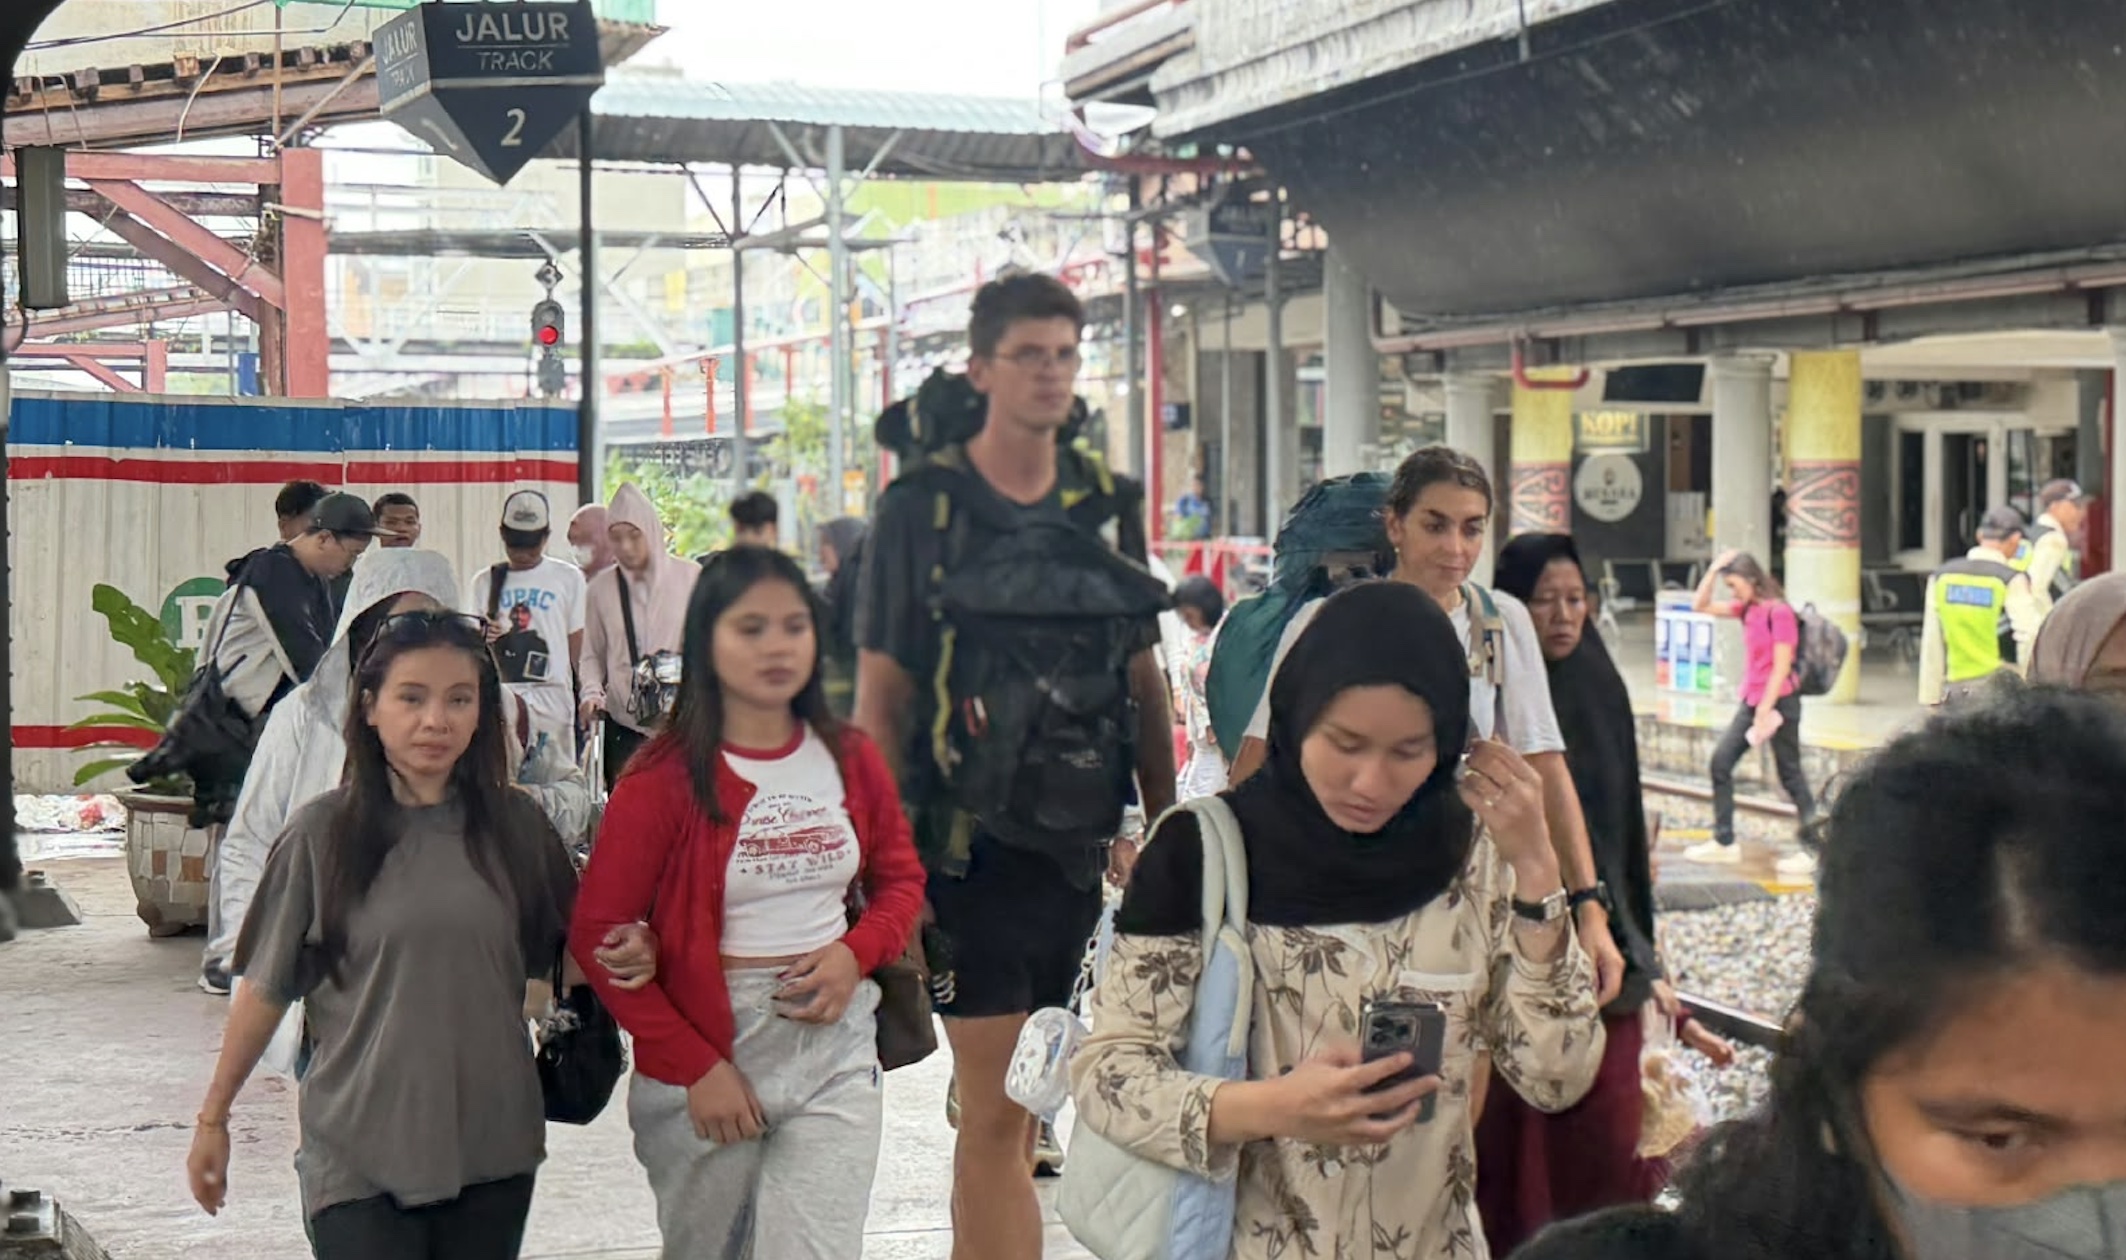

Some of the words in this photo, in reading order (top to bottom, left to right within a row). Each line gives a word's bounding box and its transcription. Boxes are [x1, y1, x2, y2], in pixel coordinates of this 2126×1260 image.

[456, 12, 570, 42] JALUR
[382, 22, 418, 64] JALUR
[476, 50, 554, 71] TRACK
[501, 108, 526, 146] 2
[541, 265, 557, 288] 3
[501, 587, 556, 614] UPAC
[755, 861, 798, 875] STAY
